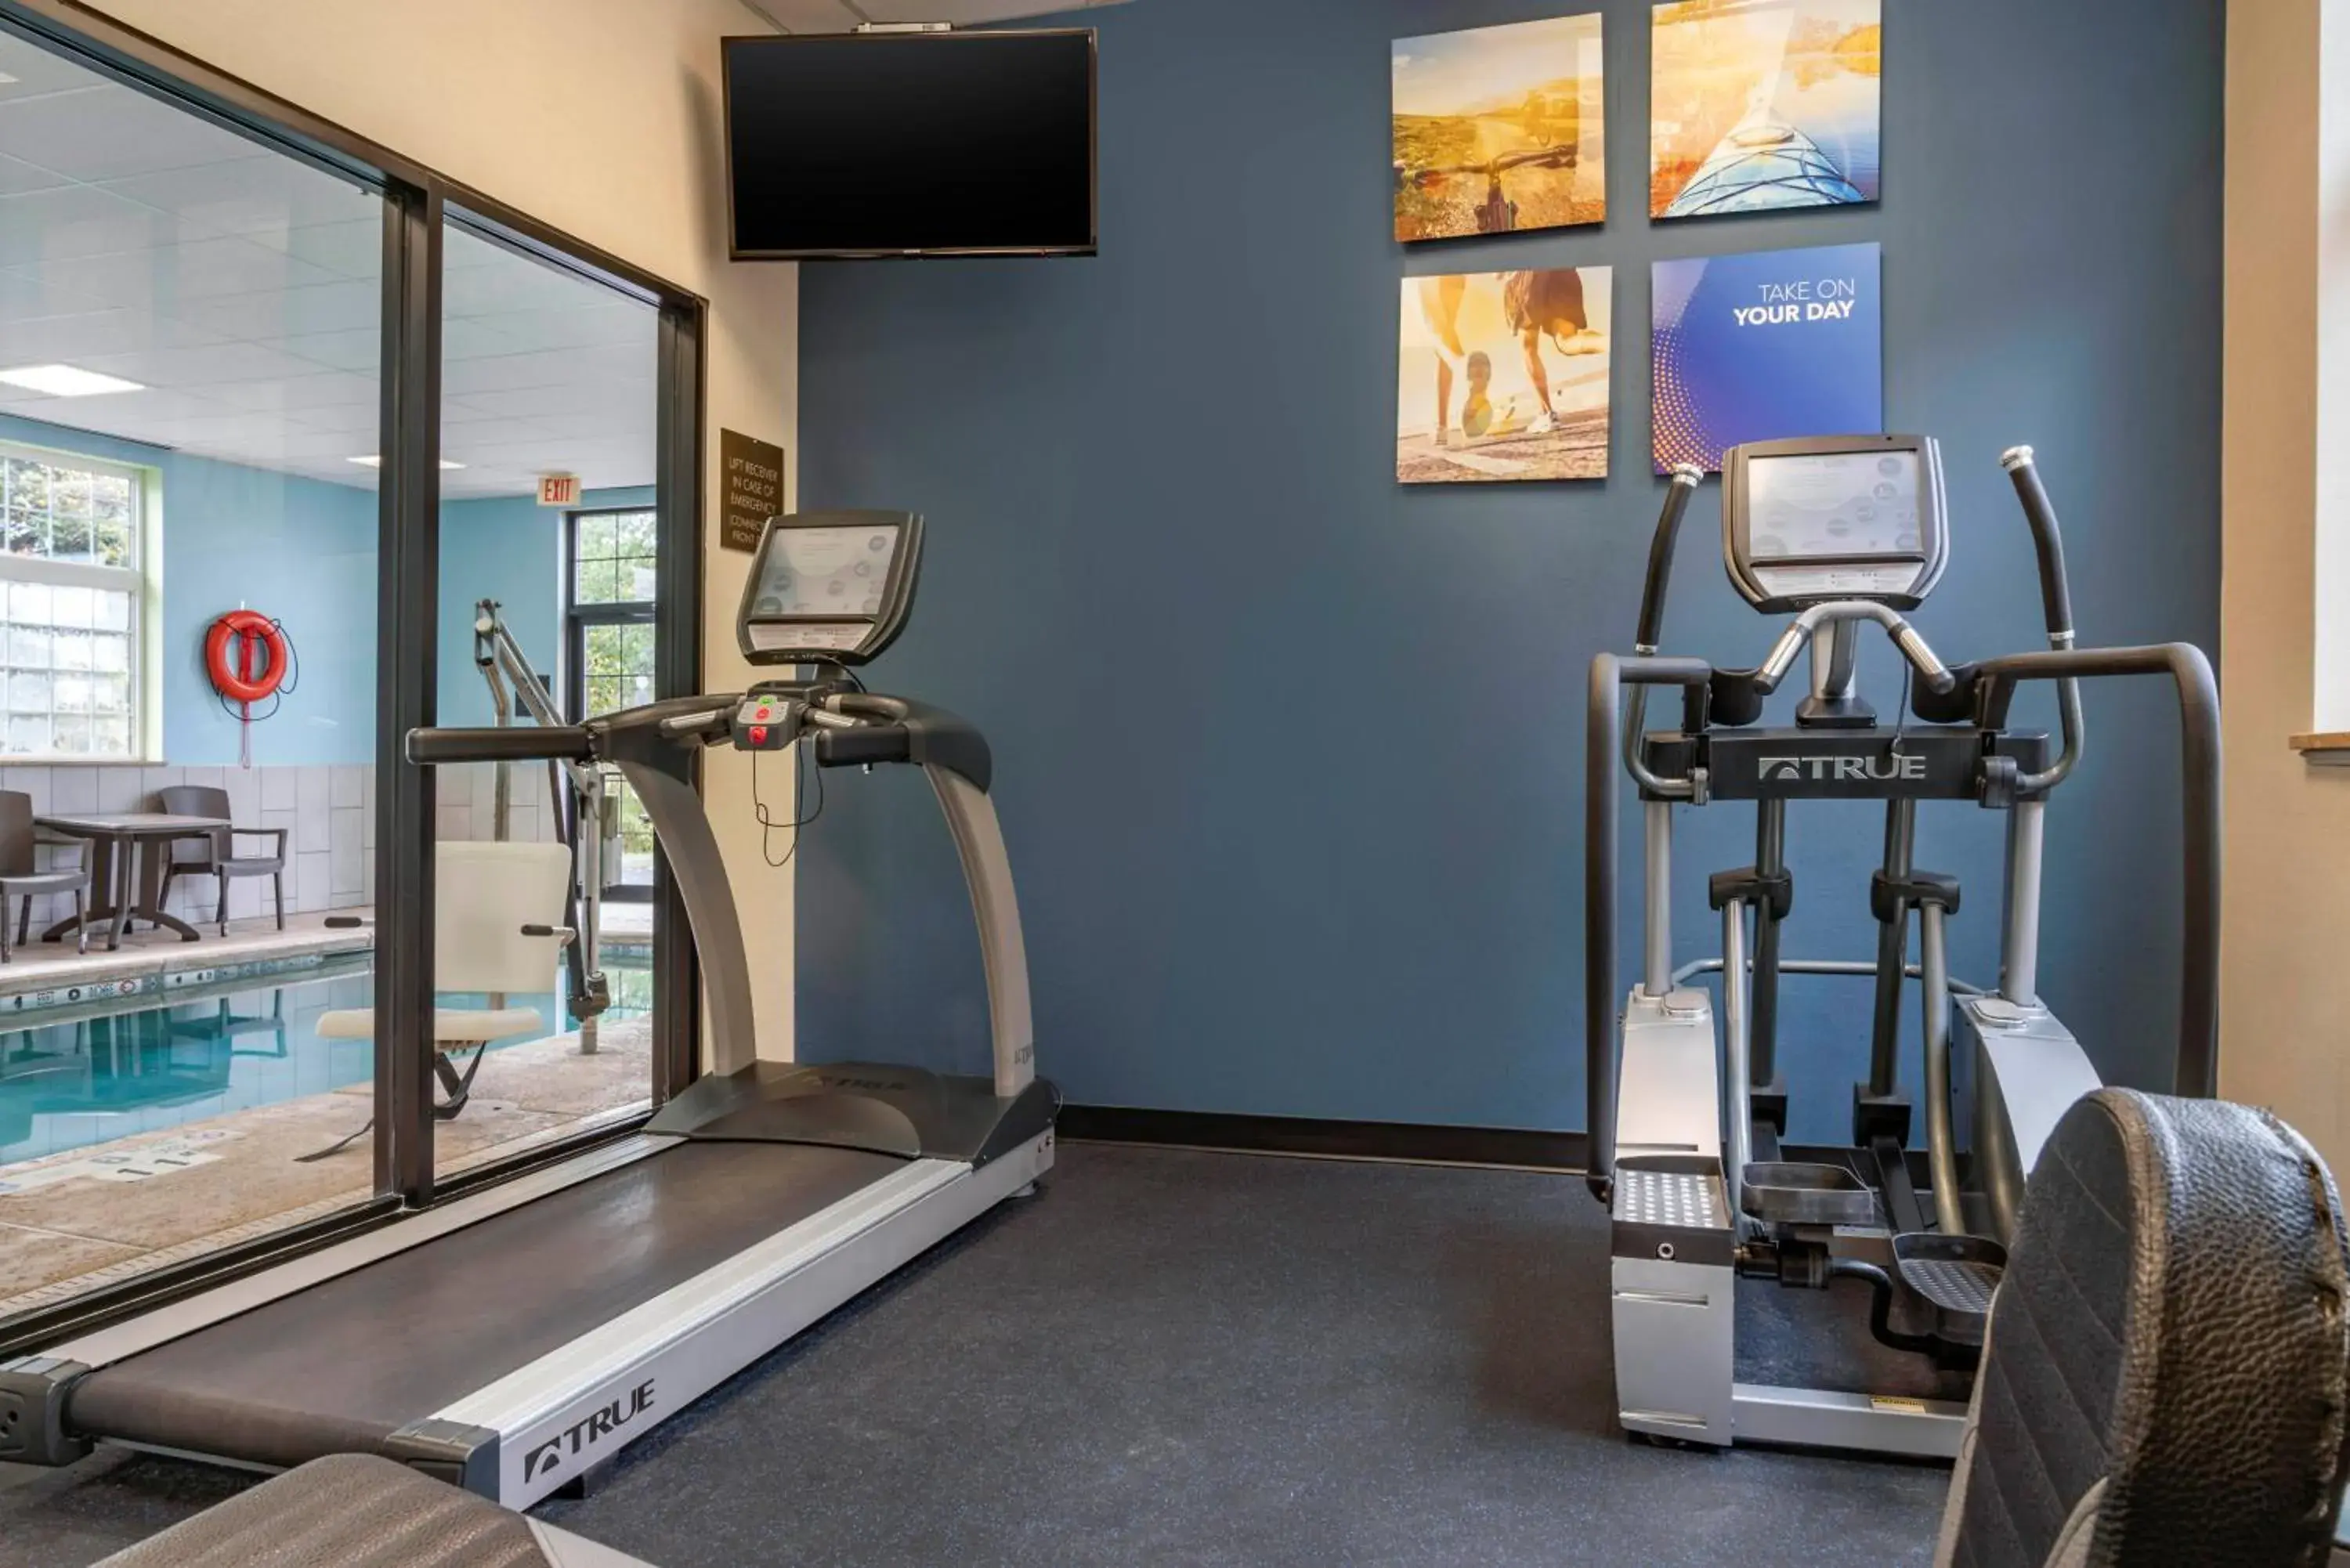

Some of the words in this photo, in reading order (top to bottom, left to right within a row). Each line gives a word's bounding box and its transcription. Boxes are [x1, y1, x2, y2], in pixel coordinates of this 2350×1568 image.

[1758, 280, 1810, 302] TAKE
[1817, 277, 1855, 298] ON
[1733, 304, 1800, 327] YOUR
[1806, 298, 1855, 320] DAY
[728, 457, 743, 471] LIFT
[745, 461, 778, 482] RECEIVER
[544, 479, 572, 502] EXIT
[732, 475, 742, 489] IN
[743, 478, 762, 495] CASE
[764, 484, 775, 497] OF
[731, 492, 776, 515] EMERGENCY
[1802, 756, 1926, 779] TRUE
[563, 1378, 655, 1455] TRUE
